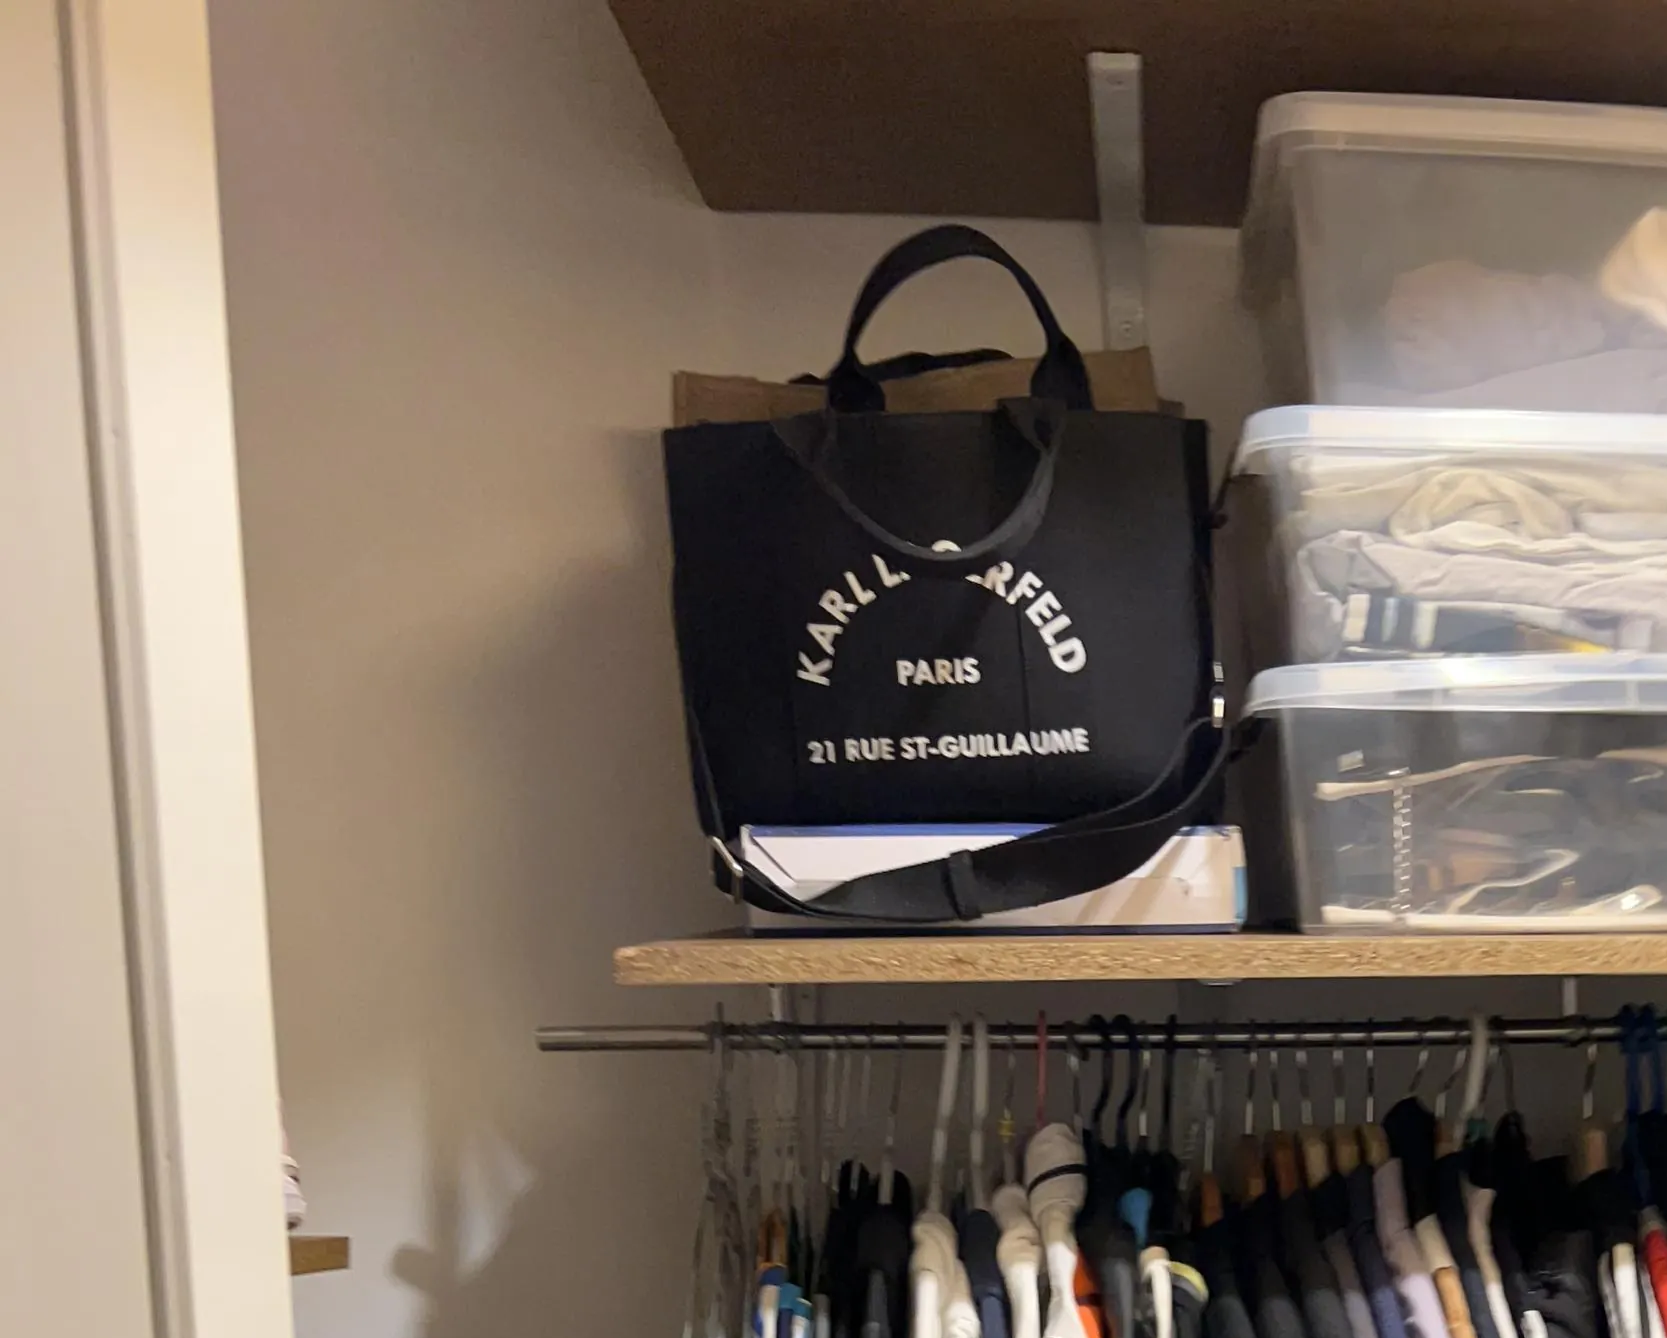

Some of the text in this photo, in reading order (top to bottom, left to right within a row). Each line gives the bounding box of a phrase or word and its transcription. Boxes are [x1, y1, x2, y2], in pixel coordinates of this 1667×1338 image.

[797, 539, 1088, 686] KARL LRFELD
[896, 656, 981, 686] PARIS
[807, 727, 1090, 764] 21 RUE ST-GUILLAUME
